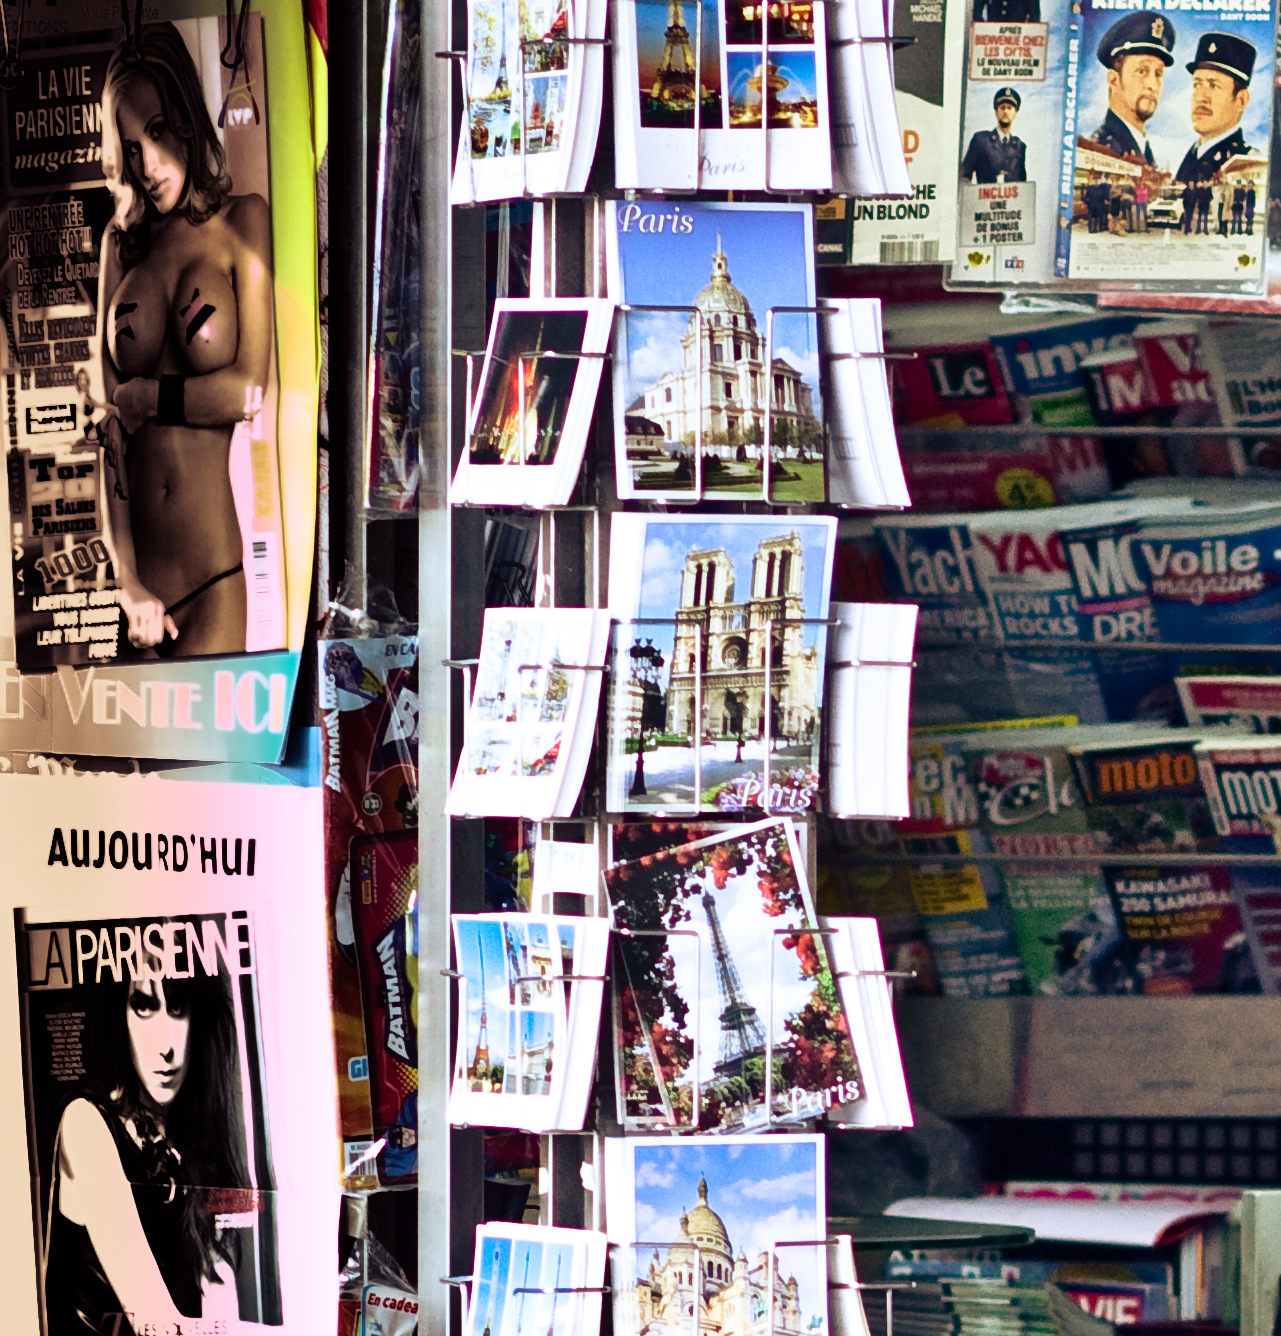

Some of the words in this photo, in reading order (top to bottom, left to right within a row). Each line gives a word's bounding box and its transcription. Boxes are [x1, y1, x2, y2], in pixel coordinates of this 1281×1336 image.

[38, 68, 60, 100] LA
[63, 65, 92, 96] VIE
[1064, 39, 1079, 132] DECLARER
[1061, 151, 1074, 195] RIEN
[877, 204, 930, 220] BLOND
[978, 186, 1018, 200] INCLUS
[618, 204, 695, 235] Paris
[974, 210, 1022, 222] MULTITUDE
[989, 232, 1023, 242] POSTER
[933, 356, 989, 398] Le
[34, 537, 112, 585] 1000
[1140, 540, 1260, 577] Voile
[1006, 615, 1078, 635] ROCKS
[56, 664, 202, 729] VENTE
[213, 669, 287, 734] ICI
[324, 709, 341, 793] BATMAN
[1101, 752, 1195, 791] moto
[735, 777, 814, 810] Paris
[47, 827, 257, 877] AUJOURD'HUI
[376, 929, 410, 1061] BATMAN
[786, 1075, 860, 1120] Paris
[368, 1293, 380, 1307] En
